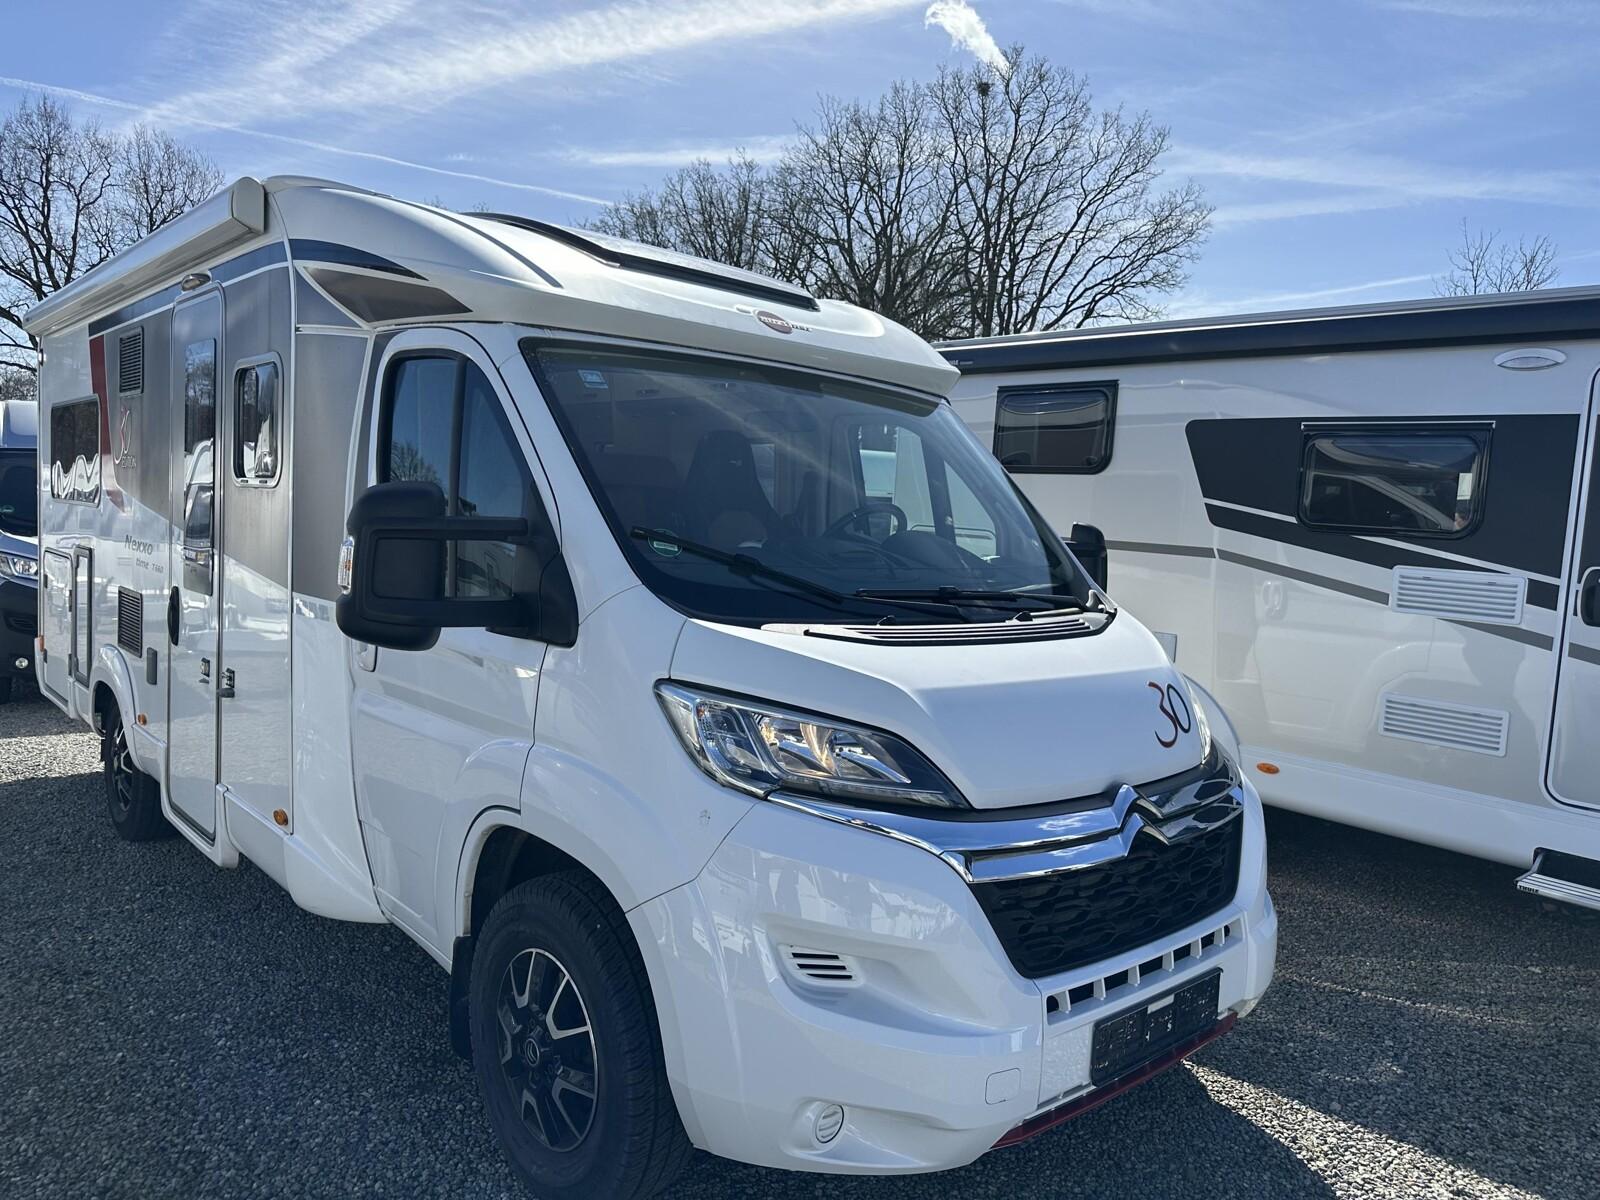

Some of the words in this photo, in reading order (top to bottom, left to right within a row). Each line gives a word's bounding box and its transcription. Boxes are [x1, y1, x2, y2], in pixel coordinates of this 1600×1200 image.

[125, 534, 153, 555] Nexxo
[1147, 682, 1191, 748] 30
[1519, 885, 1539, 894] THULE
